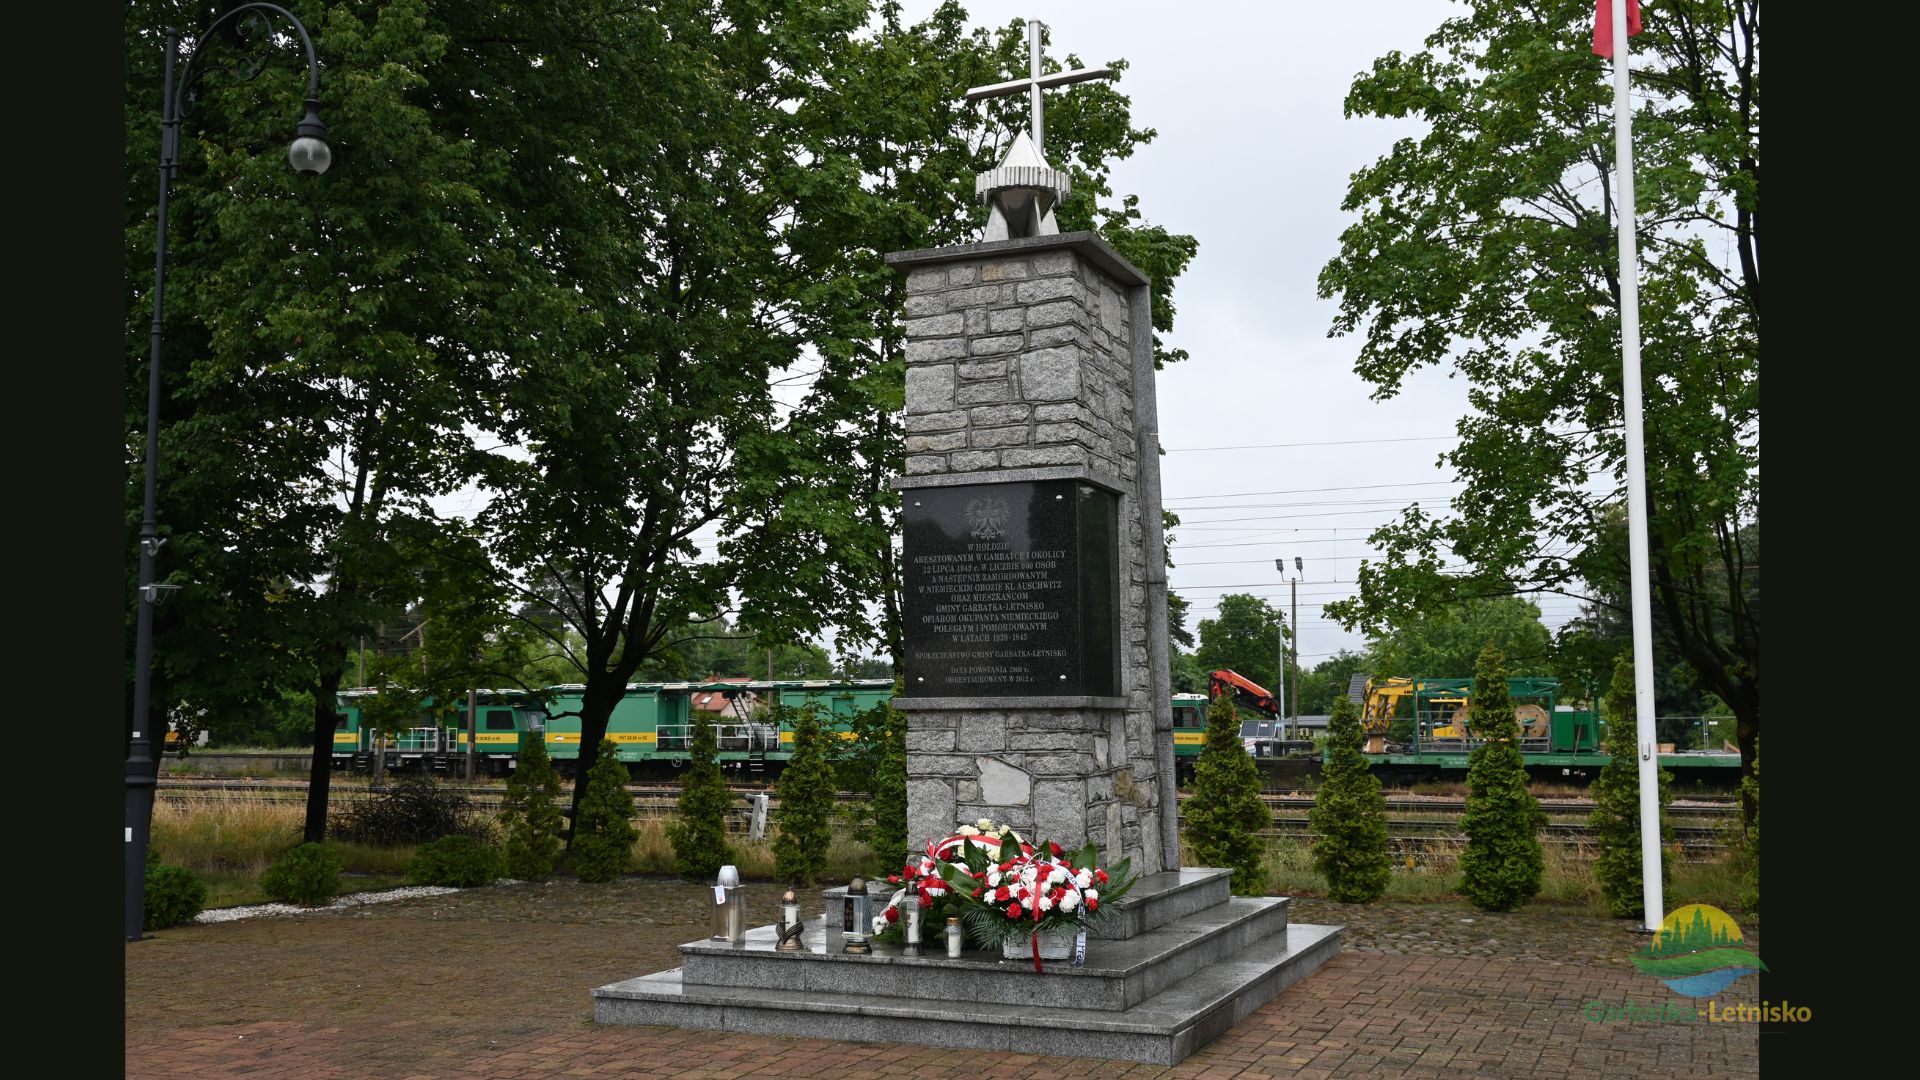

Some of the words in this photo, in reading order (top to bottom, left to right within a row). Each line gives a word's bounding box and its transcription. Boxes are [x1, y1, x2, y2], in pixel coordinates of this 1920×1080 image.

[914, 554, 974, 563] ARESZTOWANYM
[984, 552, 1026, 560] GARBATCE
[1031, 550, 1066, 559] OKOLICY
[957, 564, 971, 572] 1942
[989, 562, 1019, 571] LICZBIE
[1035, 560, 1056, 568] OSÓB
[938, 574, 980, 584] NASTĘPNIE
[982, 571, 1048, 581] ZAMORDOWANYM
[927, 584, 973, 593] NIEMIECKIM
[975, 582, 1004, 591] OBOZIE
[1005, 582, 1016, 591] KL
[1017, 581, 1063, 590] AUSCHWITZ
[951, 594, 971, 602] ORAZ
[973, 592, 1029, 602] MIESZKAŃCOM
[936, 604, 960, 613] GMINY
[962, 602, 1045, 612] GARBATKA-LETNISKO
[922, 614, 956, 623] OFIAROM
[958, 614, 999, 622] OKUPANTA
[1001, 612, 1059, 621] NIEMIECKIEGO
[934, 624, 974, 633] POLEGŁYM
[981, 622, 1047, 632] POMORDOWANYM
[960, 634, 990, 642] LATACH
[915, 650, 970, 659] SPOŁECZEŃSTWO
[995, 650, 1067, 658] GARBATKA-LETNISKO
[969, 666, 1008, 674] POWSTANIA
